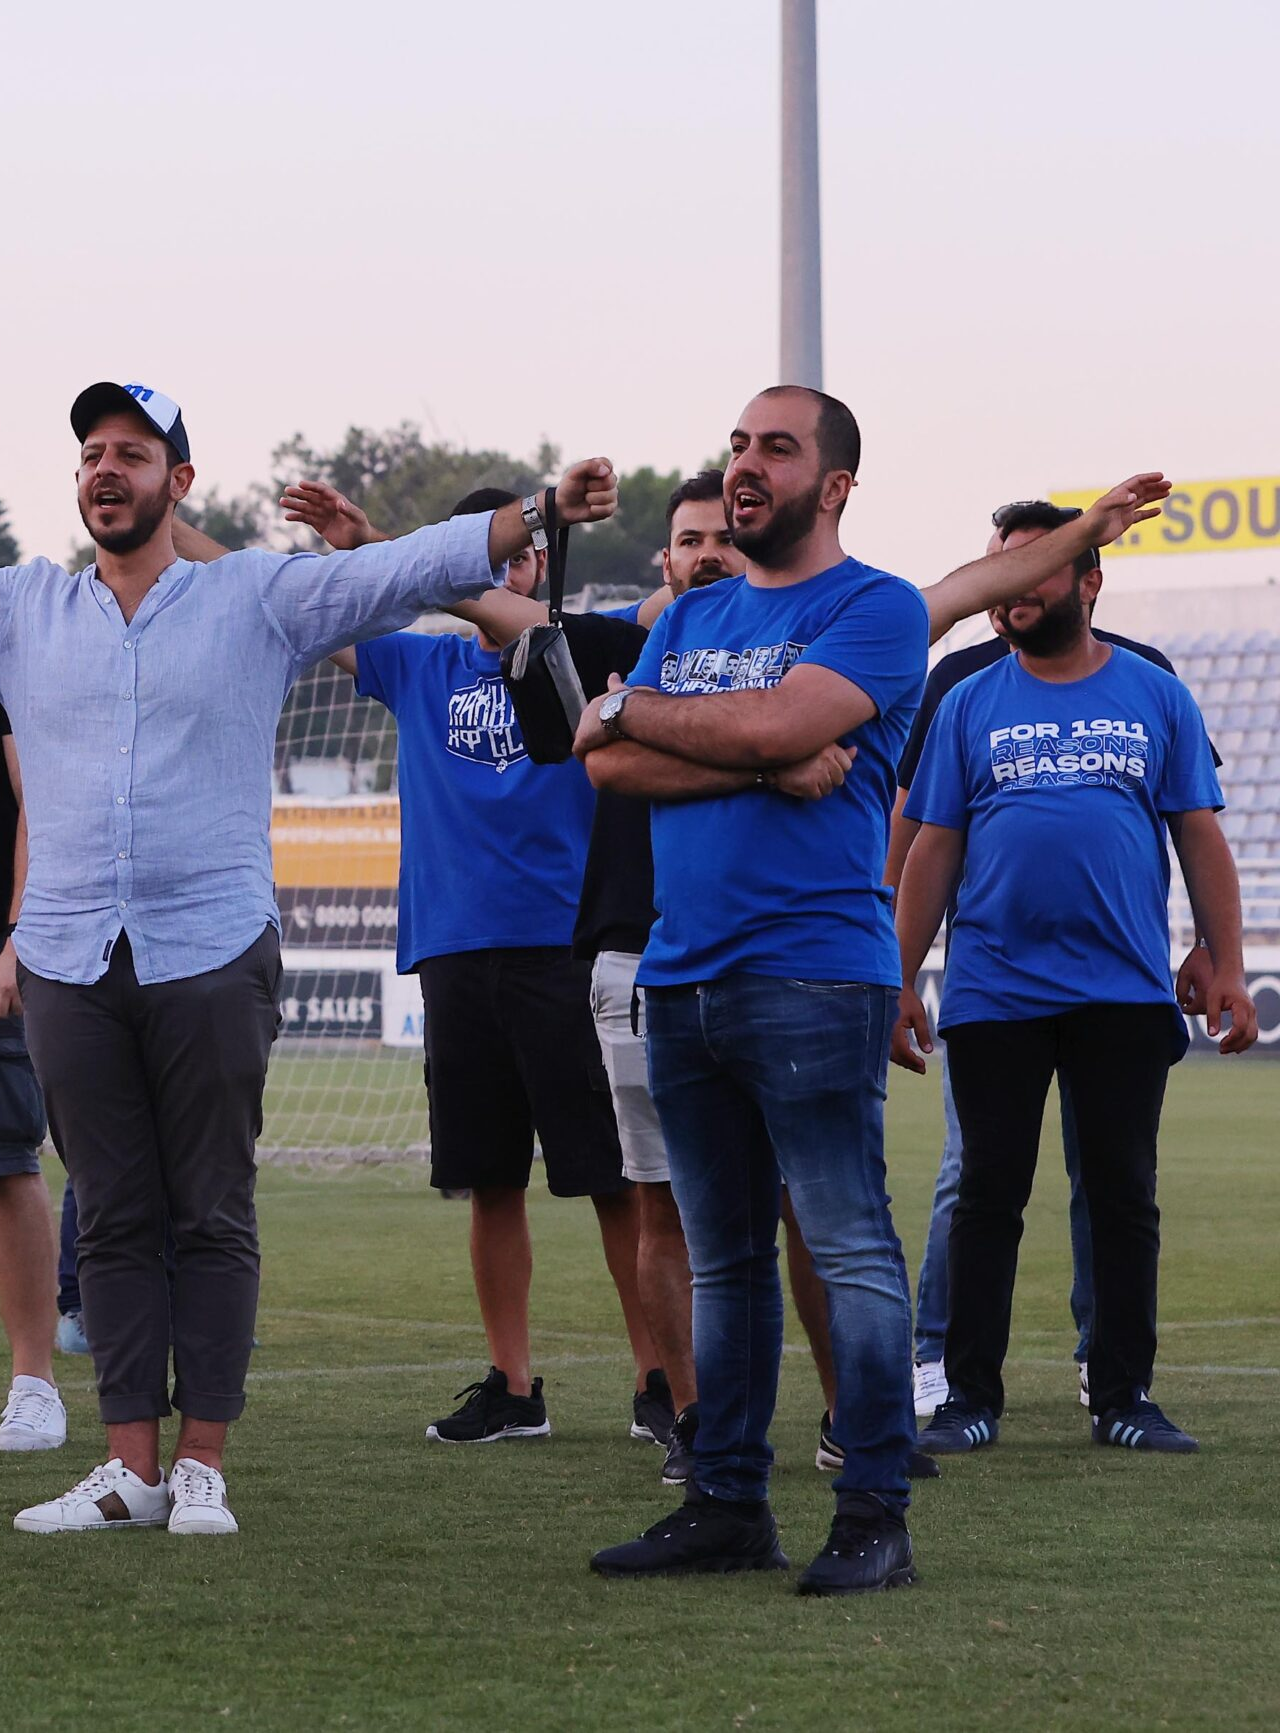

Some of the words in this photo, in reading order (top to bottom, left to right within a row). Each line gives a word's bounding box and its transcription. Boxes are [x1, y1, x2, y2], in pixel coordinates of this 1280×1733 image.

[989, 722, 1060, 748] FOR
[1071, 719, 1149, 743] 1911
[990, 735, 1148, 766] REASONS
[992, 752, 1146, 783] REASONS
[307, 996, 373, 1023] SALES
